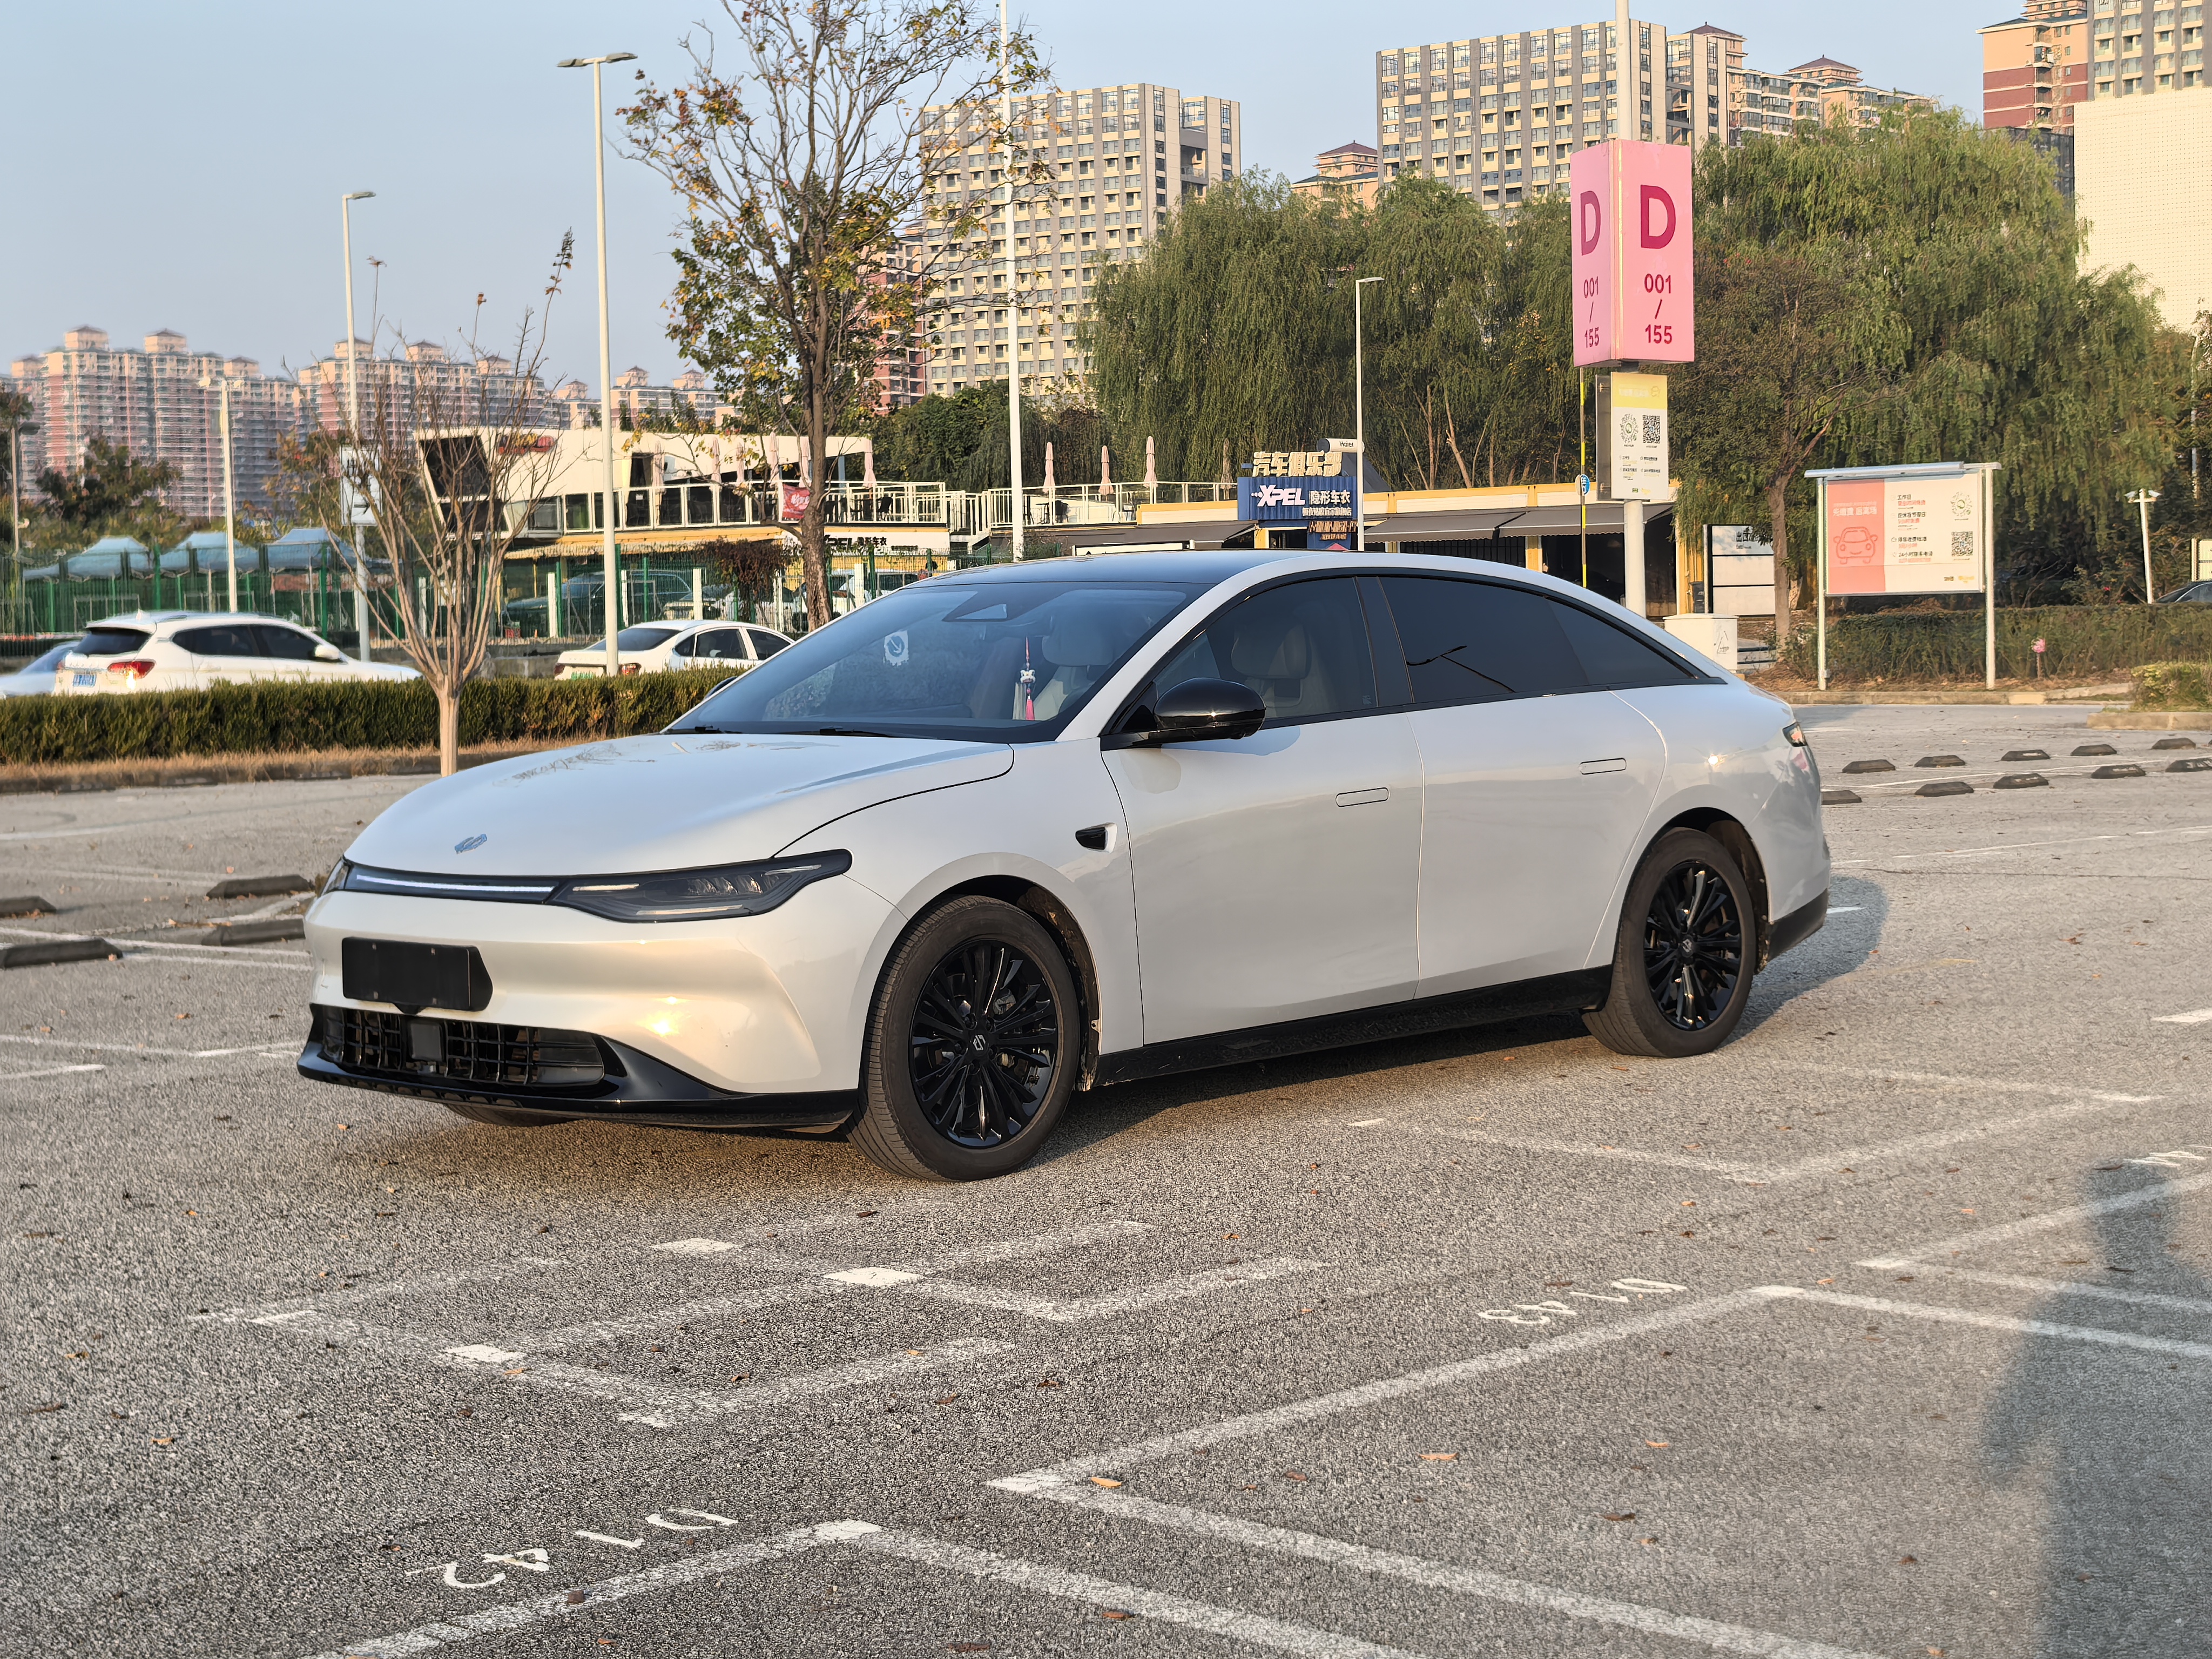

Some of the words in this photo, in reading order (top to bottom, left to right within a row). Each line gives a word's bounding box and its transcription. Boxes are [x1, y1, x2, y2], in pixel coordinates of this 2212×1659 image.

[1581, 191, 1601, 255] D
[1641, 185, 1675, 248] D
[1583, 276, 1599, 299] 001
[1644, 274, 1671, 294] 001
[1655, 299, 1662, 319] /
[1584, 327, 1599, 348] 155
[1645, 325, 1673, 345] 155
[1252, 451, 1342, 477] 汽车俱乐部
[1257, 485, 1305, 507] XPEL
[1309, 490, 1351, 505] 隐形车衣
